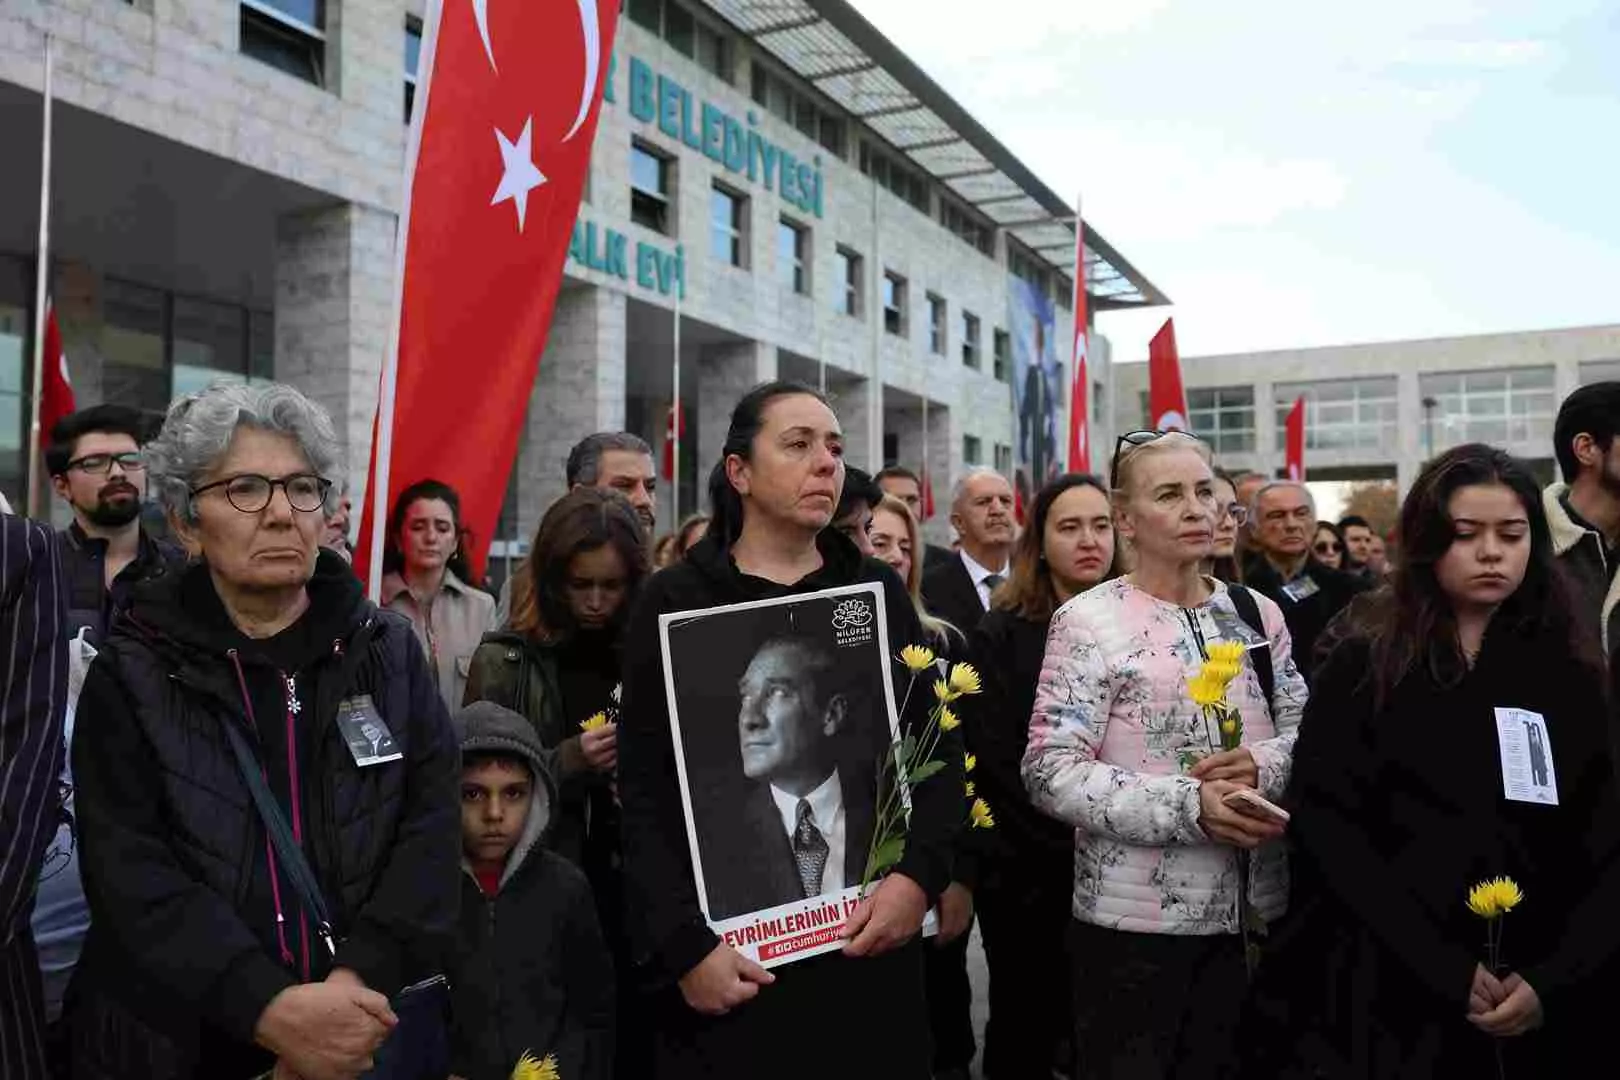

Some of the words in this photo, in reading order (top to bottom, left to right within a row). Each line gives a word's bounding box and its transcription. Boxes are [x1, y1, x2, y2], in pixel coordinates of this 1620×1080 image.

[629, 55, 822, 218] BELEDİYESİ
[568, 217, 628, 281] ALK
[637, 242, 685, 300] EVİ
[720, 901, 840, 948] EVRİMLERİNİN
